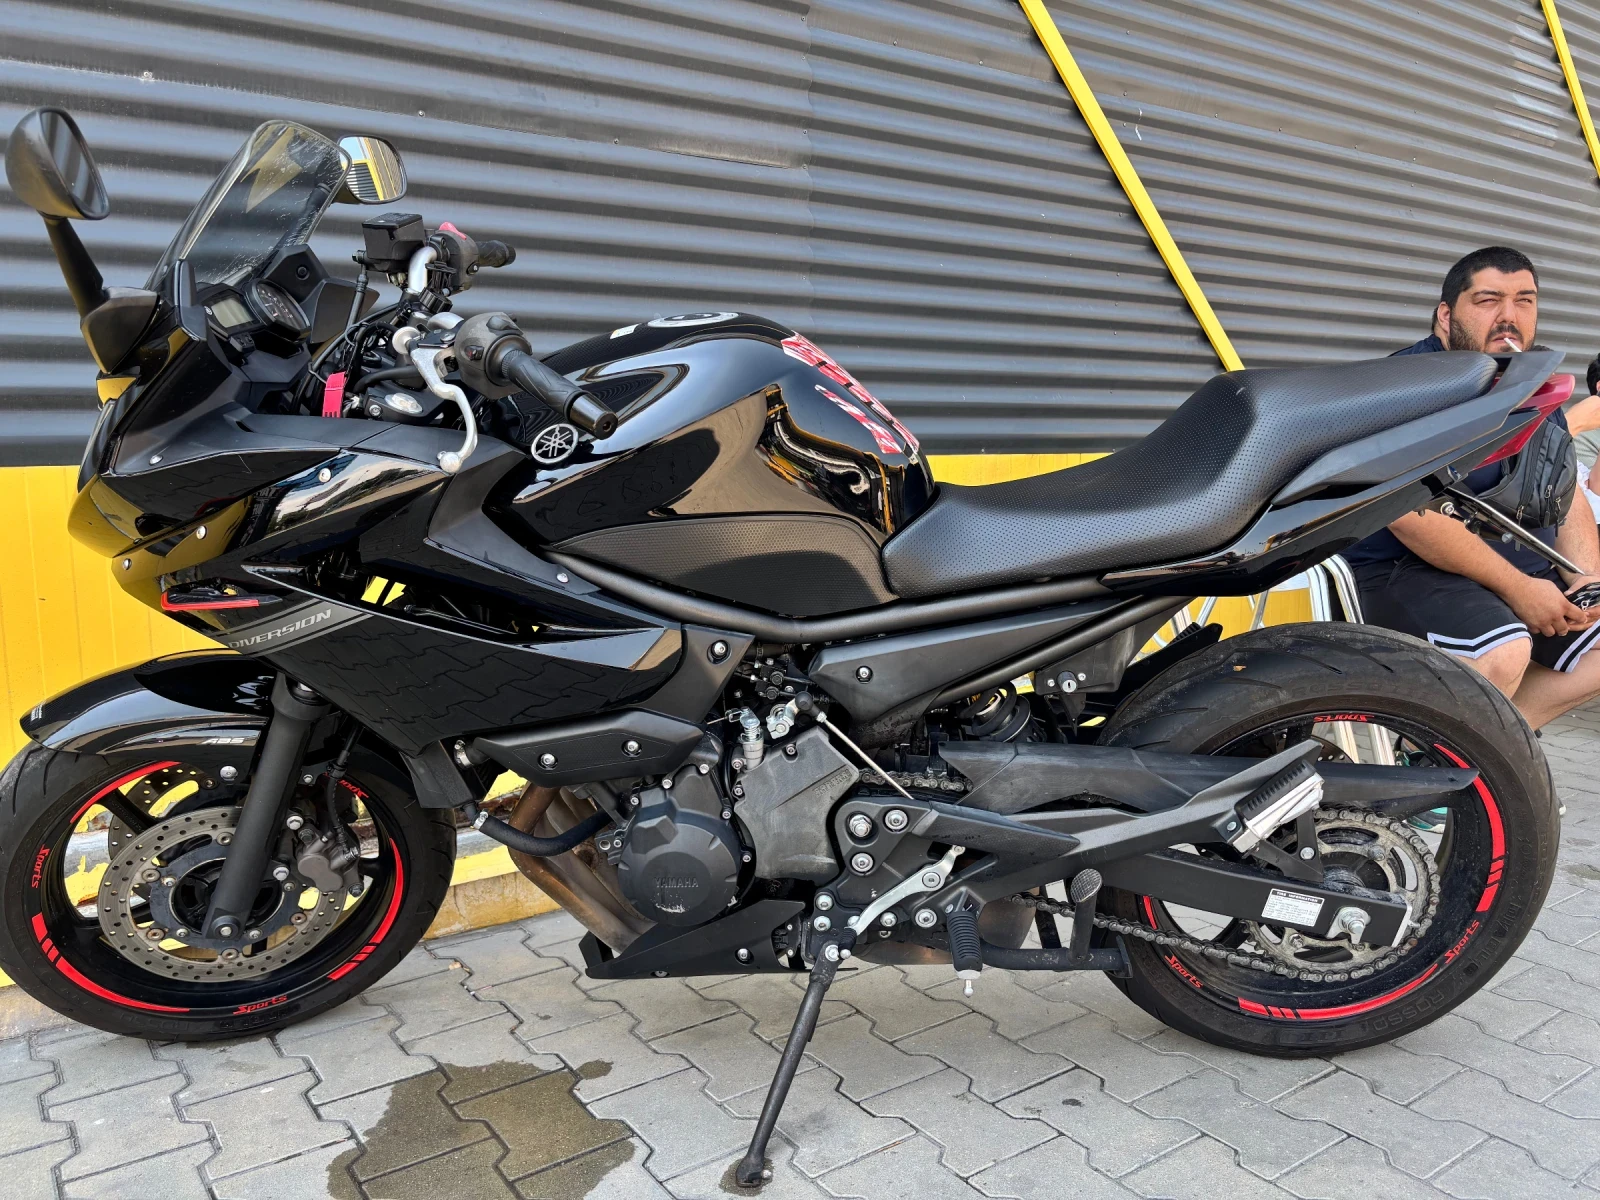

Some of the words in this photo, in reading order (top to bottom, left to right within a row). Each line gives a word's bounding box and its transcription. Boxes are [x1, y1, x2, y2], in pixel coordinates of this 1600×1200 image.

[228, 609, 331, 648] DIVERSION
[1313, 714, 1374, 722] Sports
[32, 844, 50, 888] Sports
[655, 876, 699, 888] YAMAHA
[1445, 920, 1480, 964] Sports
[1165, 955, 1203, 988] Sports
[233, 995, 288, 1014] Sports
